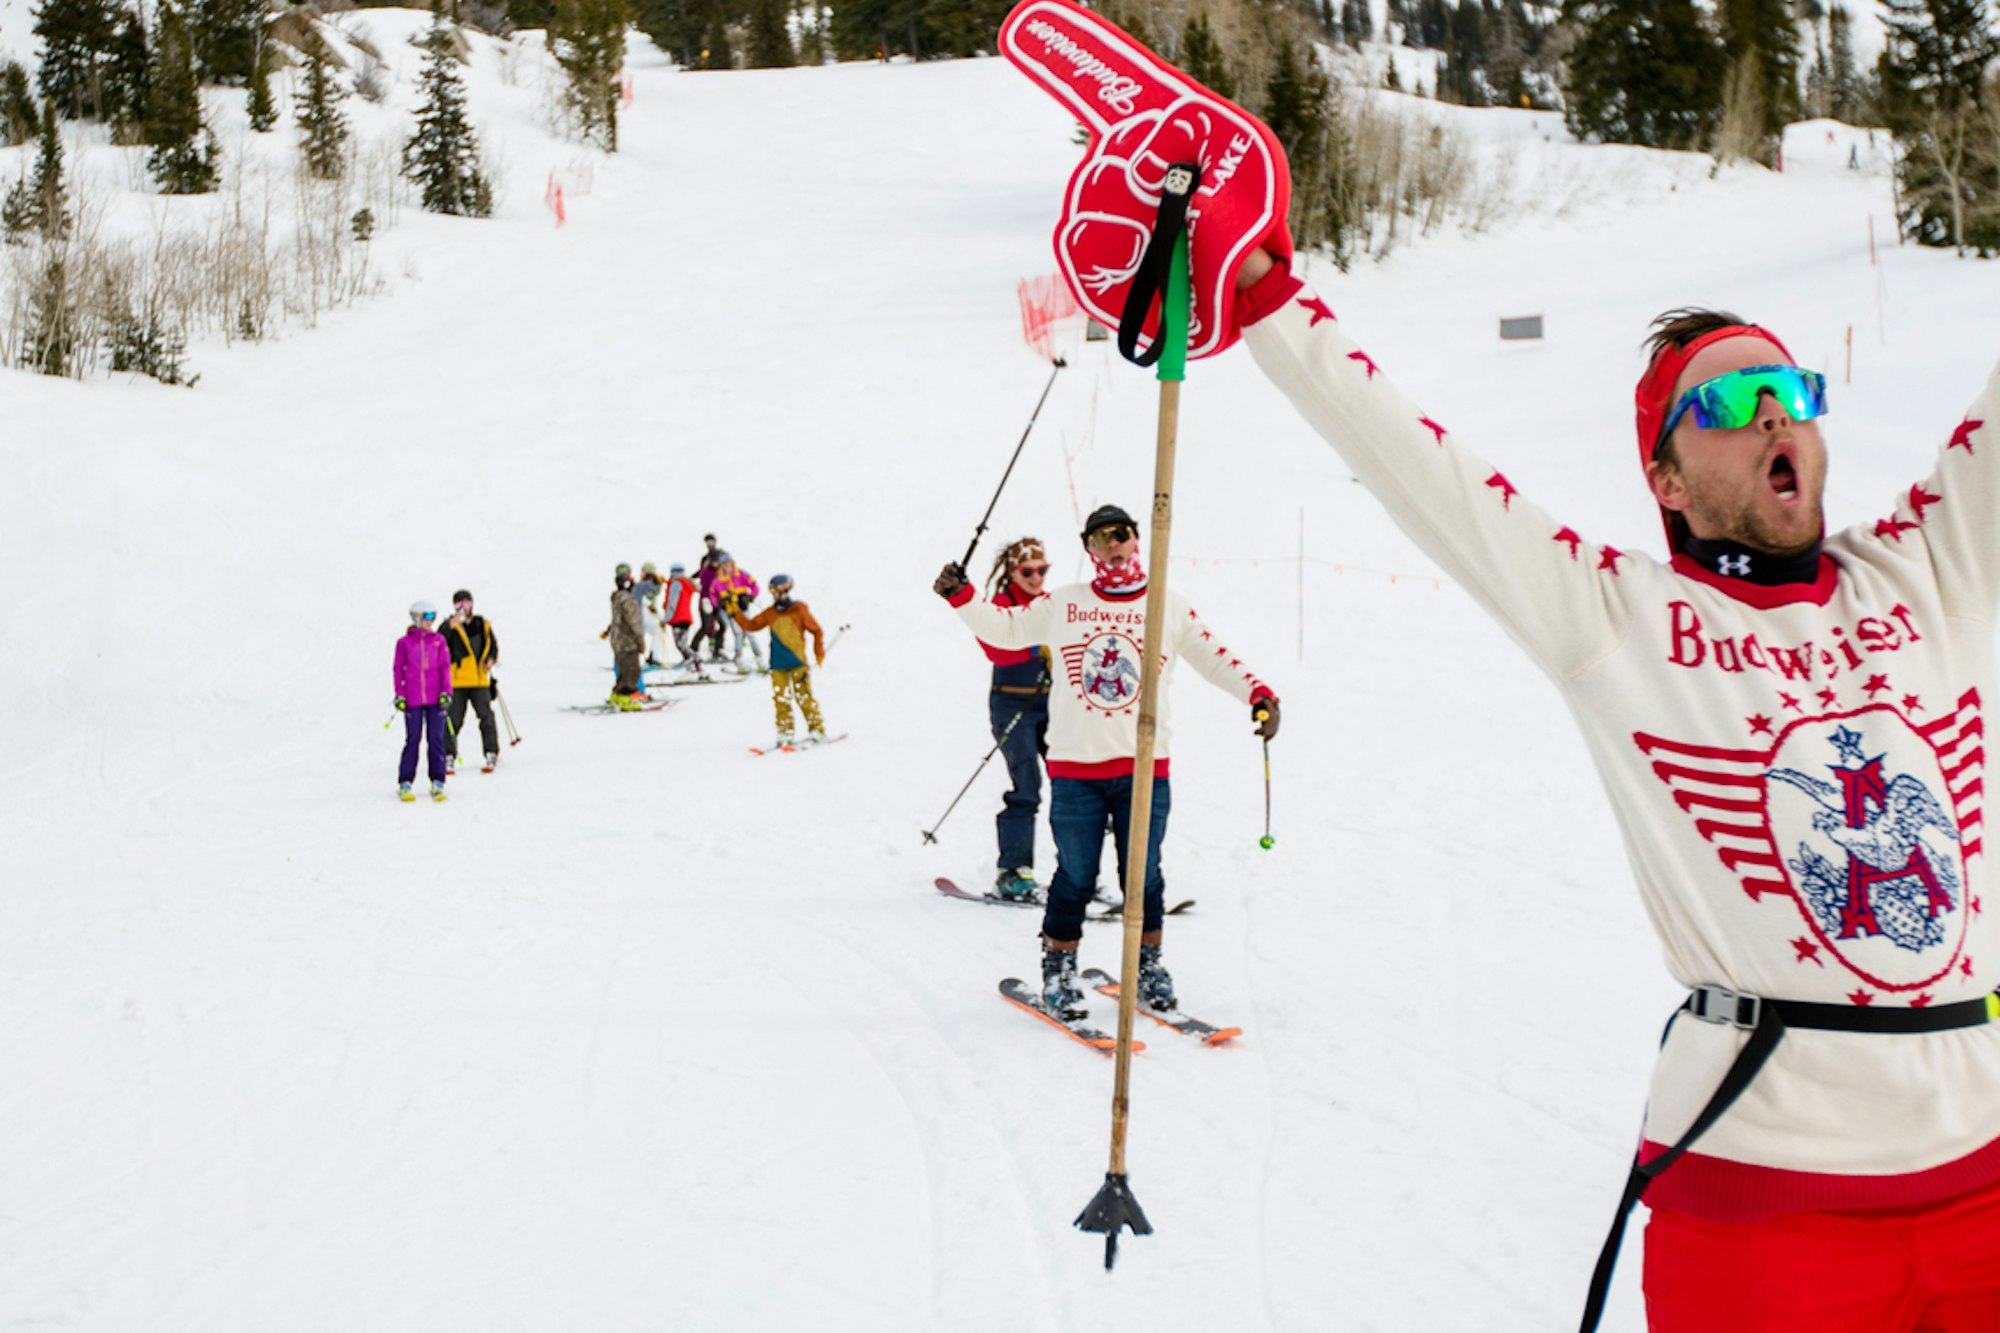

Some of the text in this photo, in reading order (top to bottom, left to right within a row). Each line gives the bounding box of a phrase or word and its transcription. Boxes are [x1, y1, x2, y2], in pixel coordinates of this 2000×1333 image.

[1026, 19, 1143, 116] Budweiser
[1197, 132, 1252, 197] LAKE
[1066, 603, 1146, 625] Budweis
